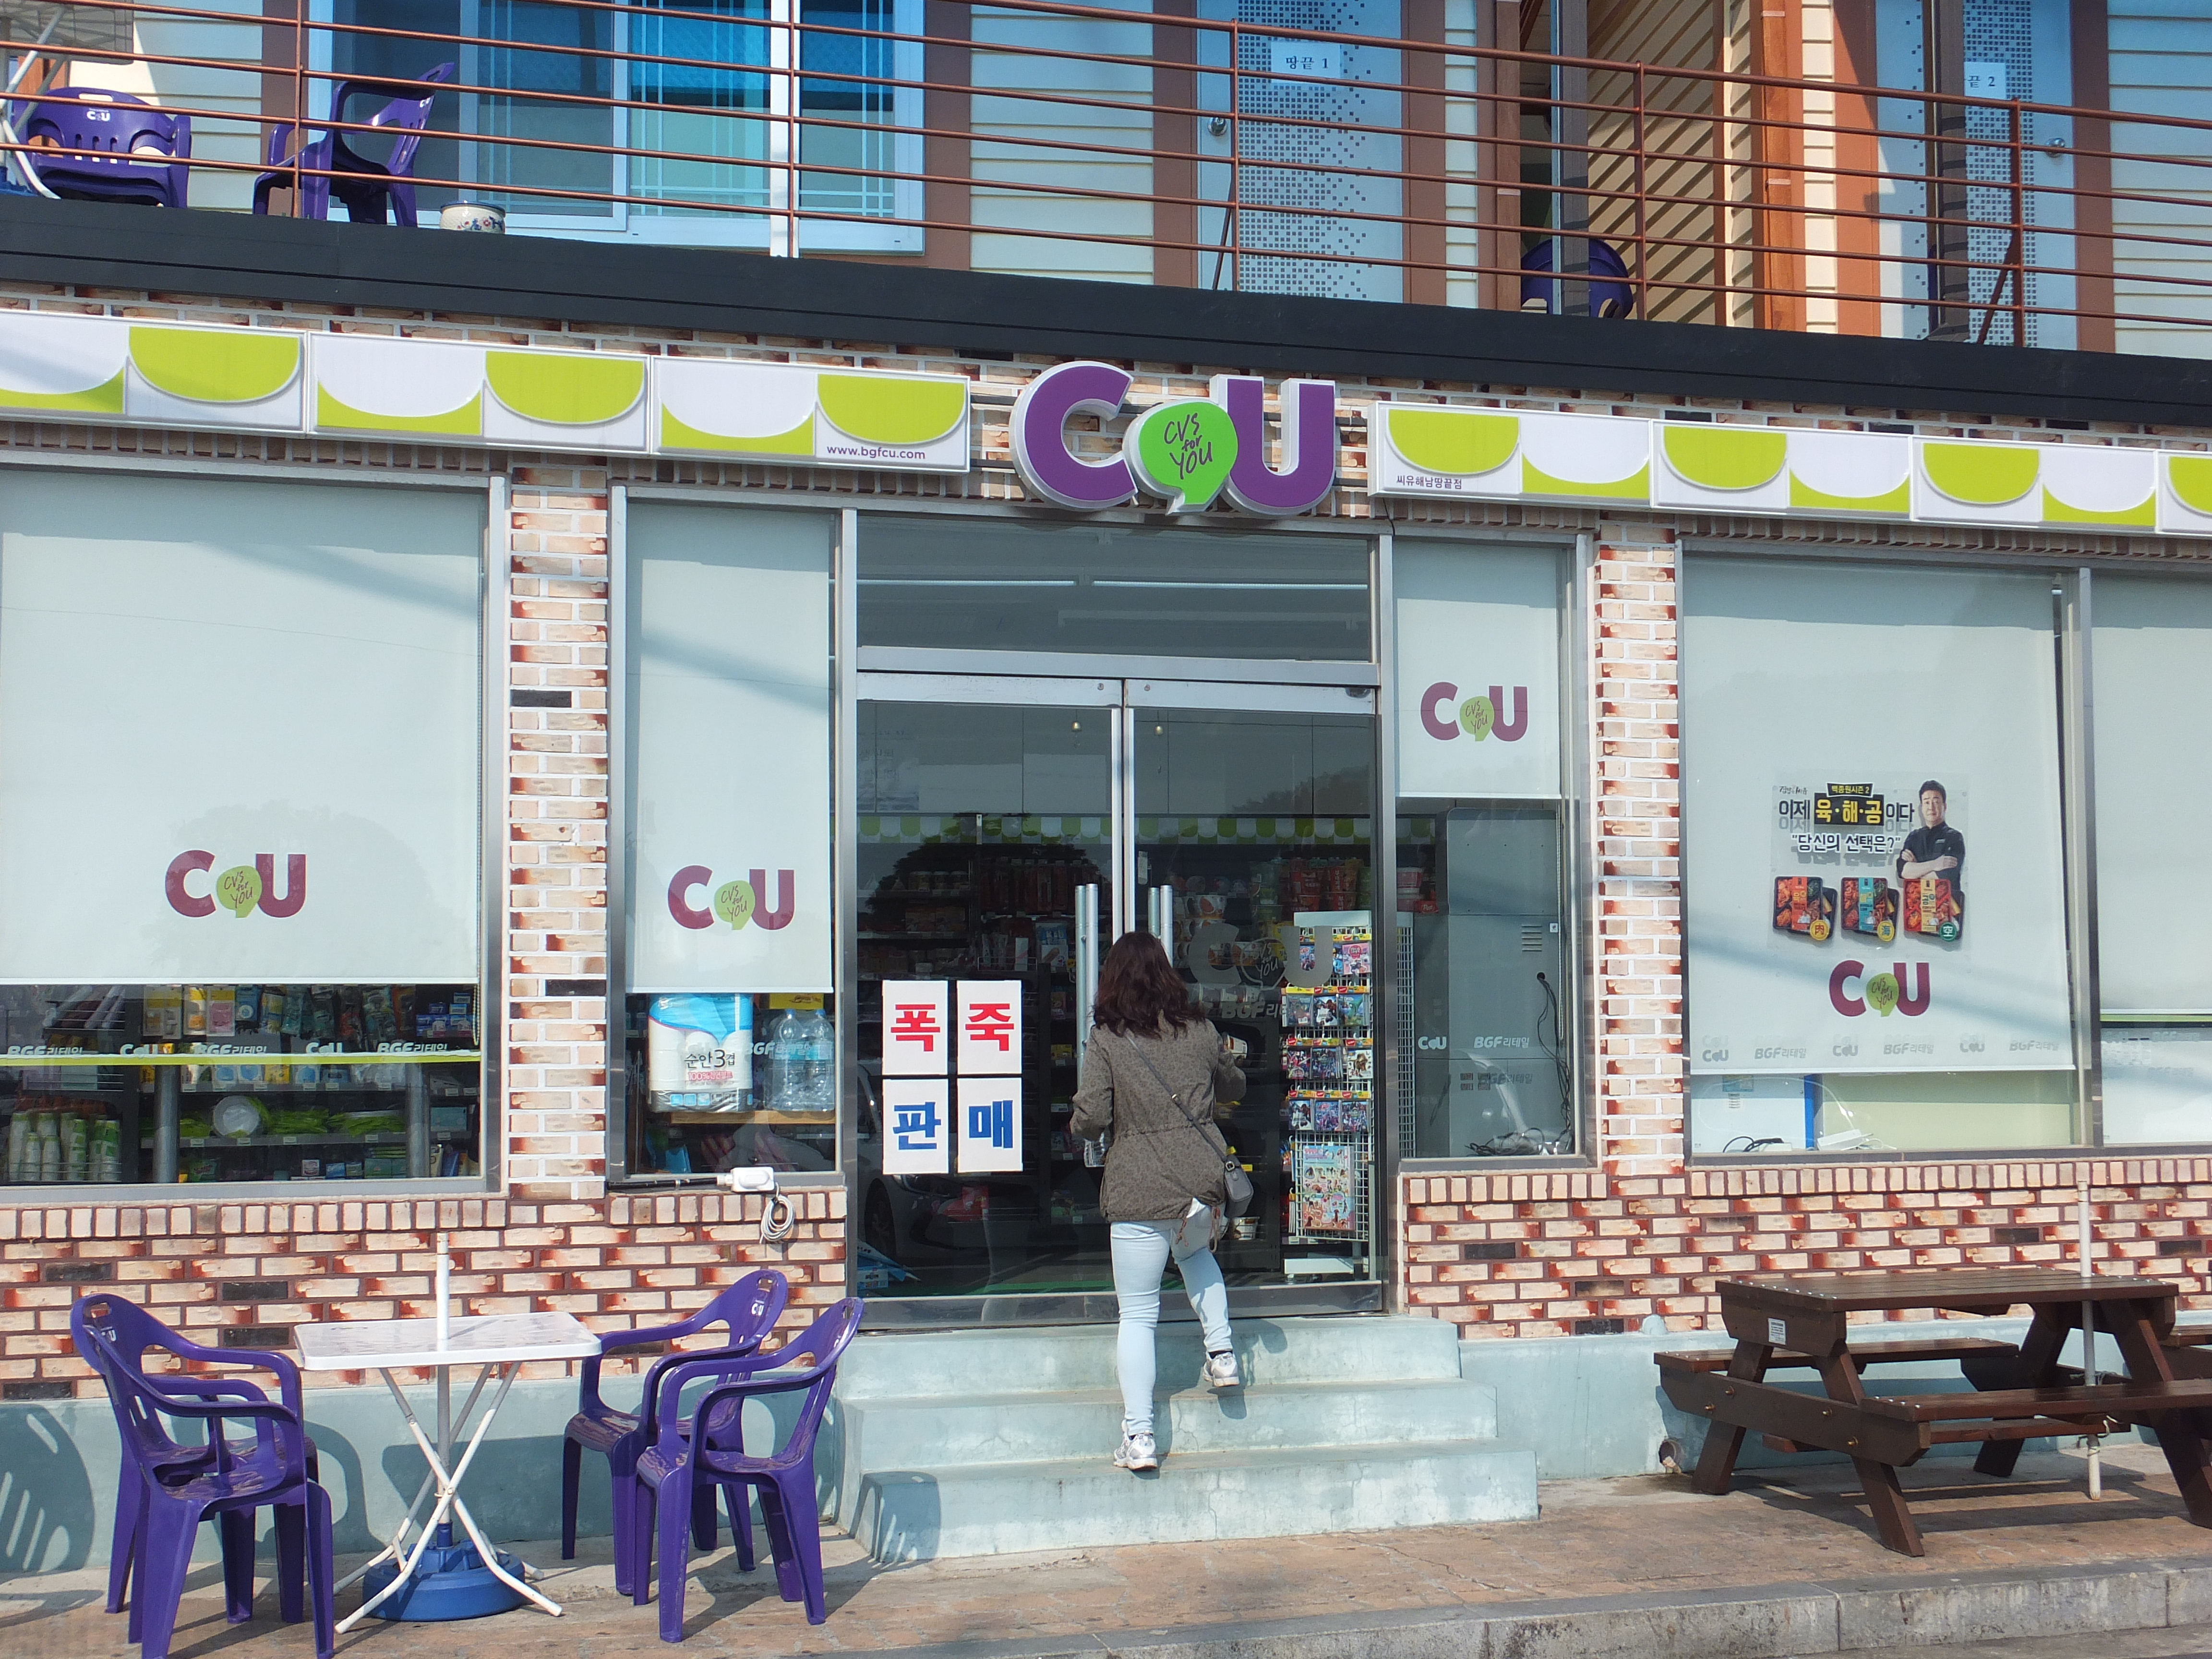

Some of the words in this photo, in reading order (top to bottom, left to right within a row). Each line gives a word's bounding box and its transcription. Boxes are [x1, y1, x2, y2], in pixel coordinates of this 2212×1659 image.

[1286, 56, 1314, 70] 땅끝
[1322, 58, 1328, 69] 1
[1988, 76, 1995, 87] 2
[87, 110, 110, 121] CU
[1013, 361, 1335, 513] CU
[1164, 412, 1200, 444] CVS
[827, 446, 926, 459] www.bgfcu.com
[1181, 434, 1202, 452] for
[1169, 441, 1213, 480] YOU
[1396, 475, 1462, 490] 씨유해남땅끝점
[1420, 682, 1528, 742] CU
[1466, 700, 1480, 717] CVS
[1470, 714, 1488, 733] YOU
[1779, 799, 1810, 819] 이제
[1886, 802, 1915, 822] 이다
[165, 850, 306, 918] CU
[224, 871, 243, 890] CVS
[230, 887, 252, 909] YOU
[668, 865, 794, 930] CU
[721, 885, 739, 903] CVS
[727, 901, 747, 921] YOU
[1255, 958, 1279, 980] YOU
[1829, 960, 1930, 1017] CU
[1871, 977, 1886, 993] CVS
[1876, 991, 1893, 1009] YOU
[1418, 1036, 1447, 1050] CU
[1473, 1036, 1530, 1048] BGF리테일
[1702, 1049, 1729, 1062] CU
[1755, 1047, 1807, 1059] BGF리테일
